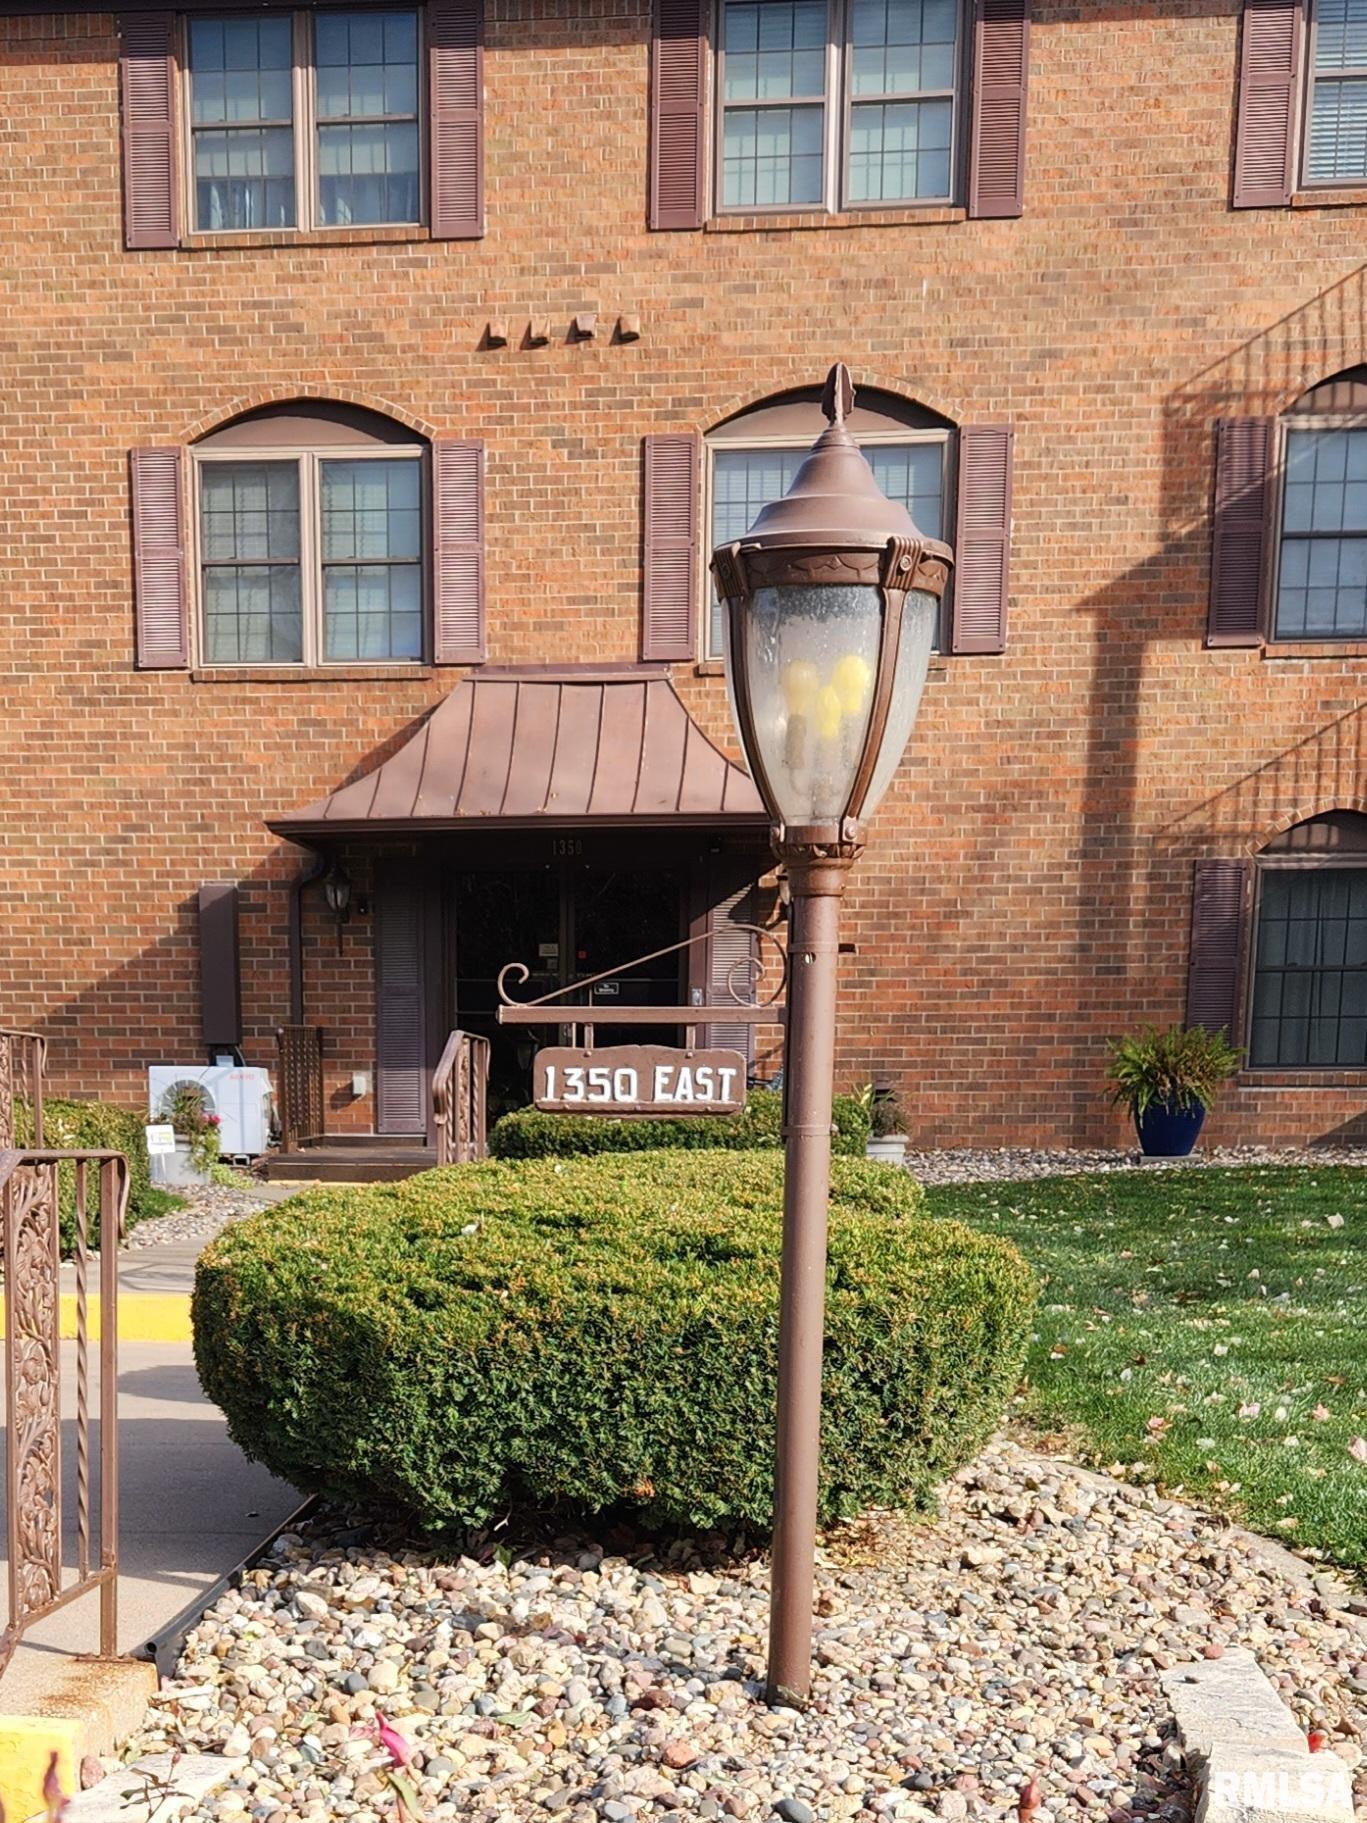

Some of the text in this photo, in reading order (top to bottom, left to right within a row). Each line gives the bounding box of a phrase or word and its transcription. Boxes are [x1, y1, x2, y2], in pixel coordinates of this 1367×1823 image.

[552, 839, 583, 856] 1350
[543, 1065, 737, 1102] 1350 EAST
